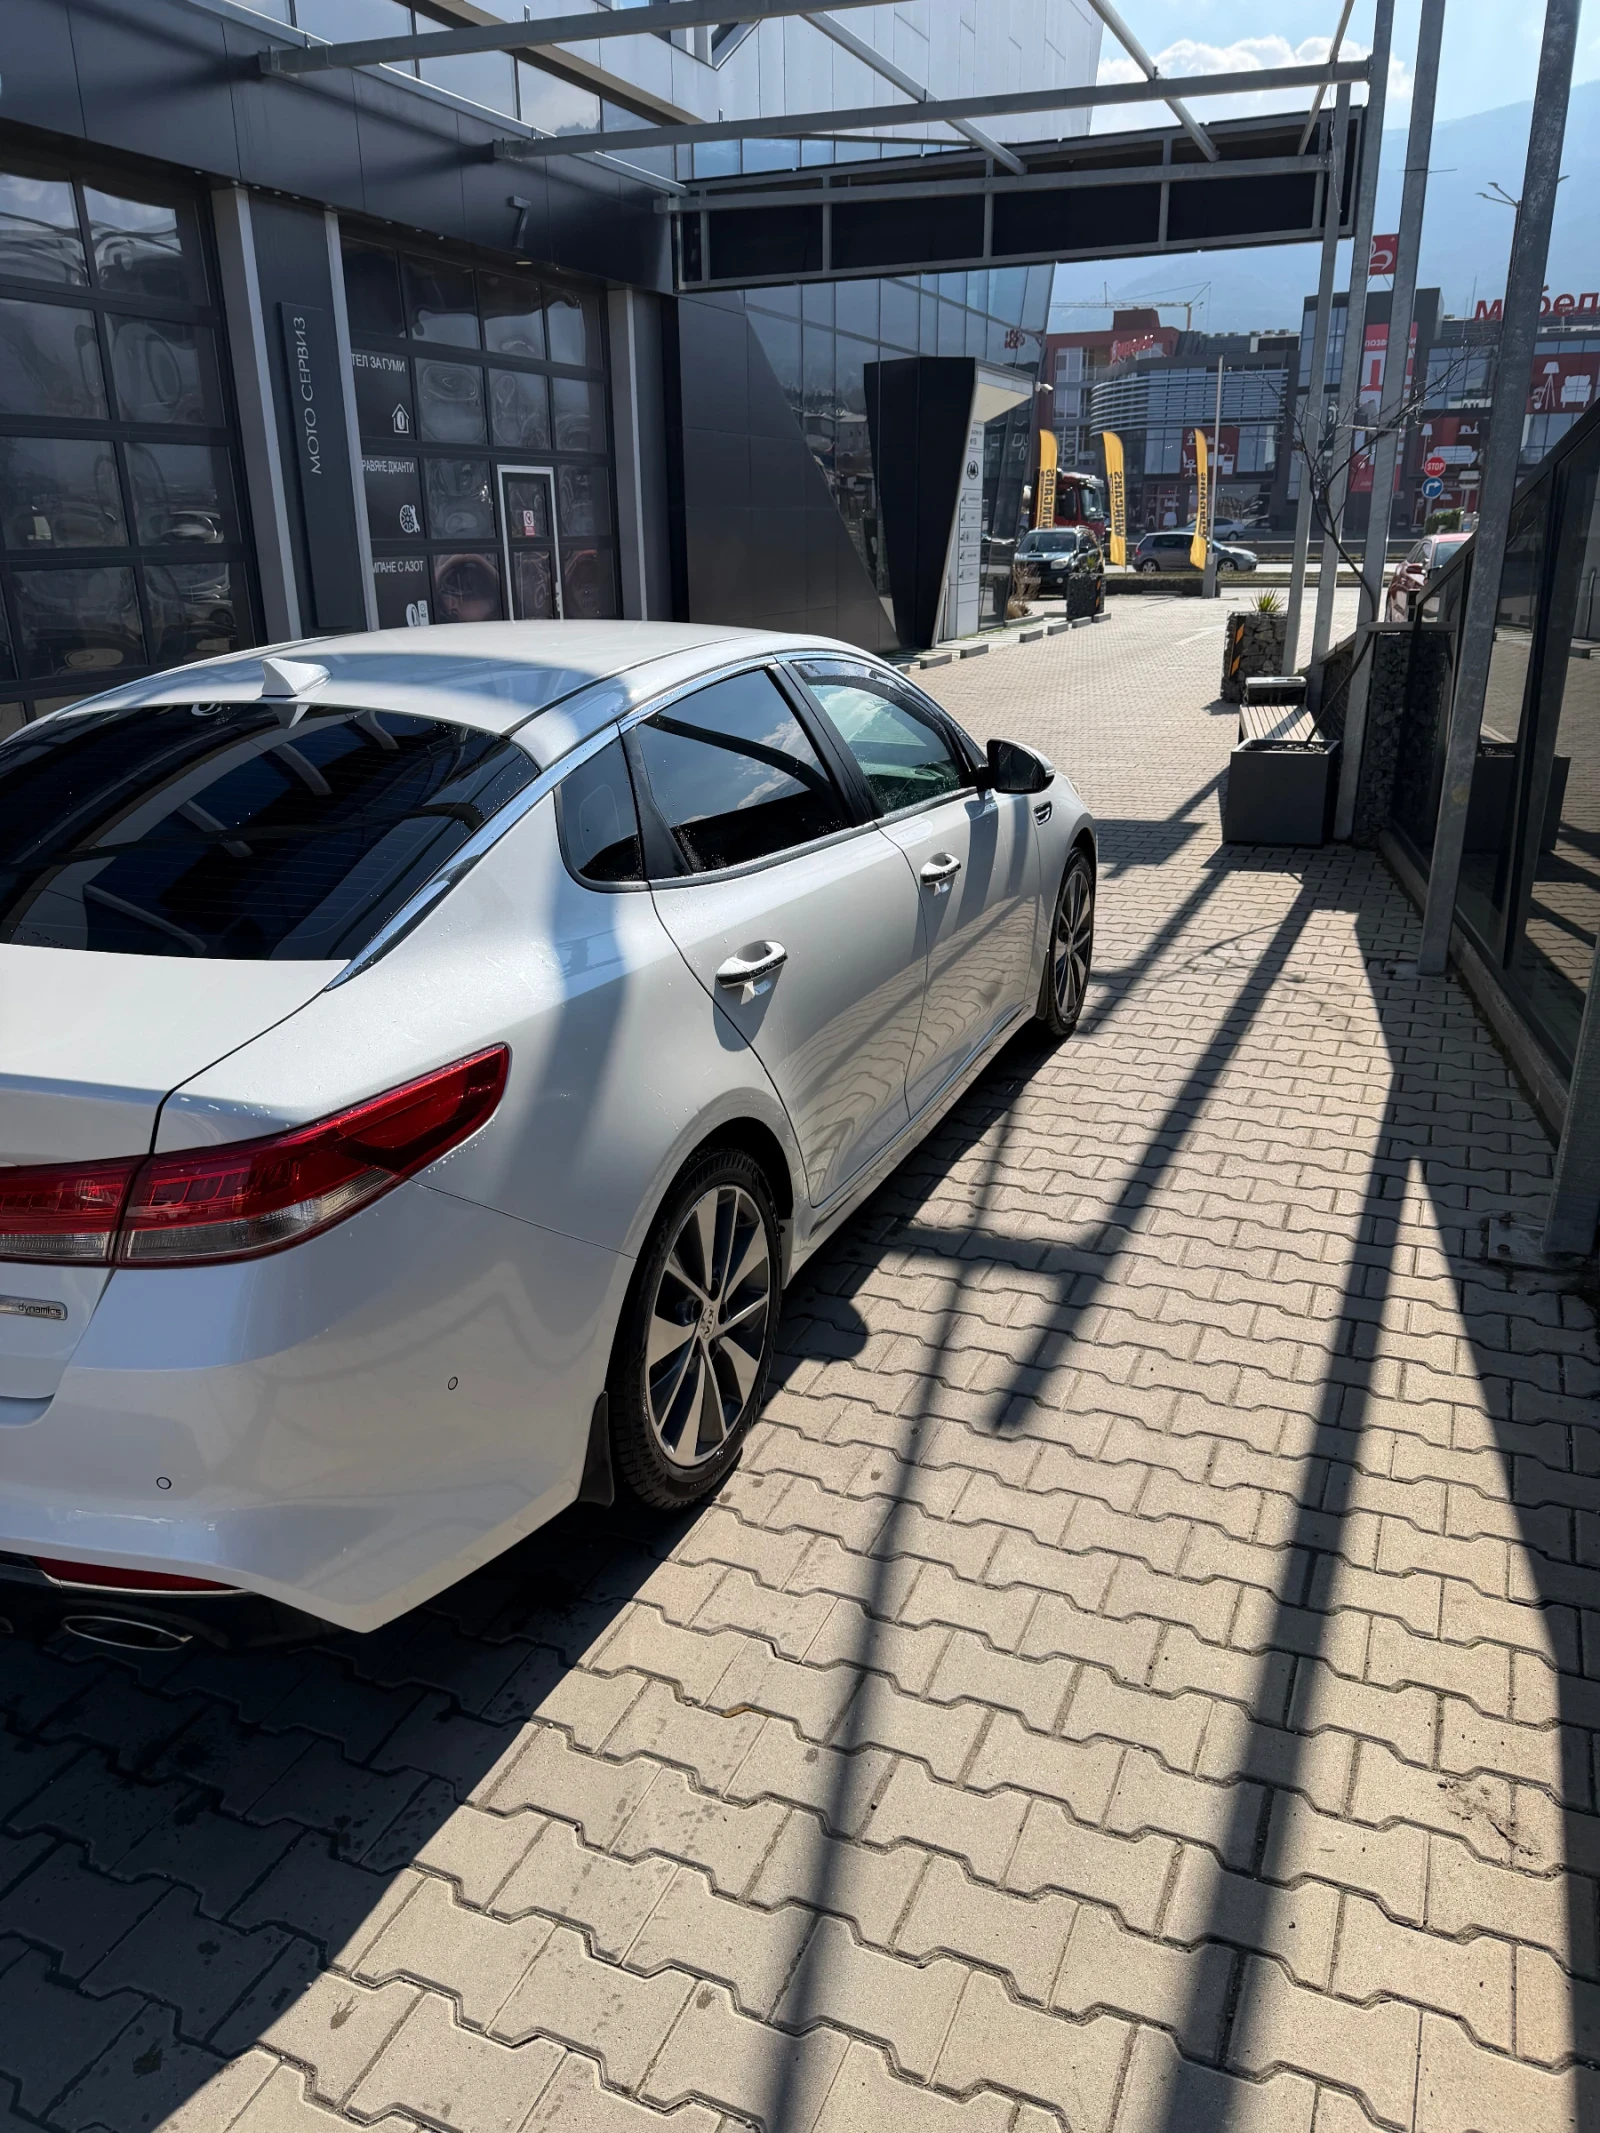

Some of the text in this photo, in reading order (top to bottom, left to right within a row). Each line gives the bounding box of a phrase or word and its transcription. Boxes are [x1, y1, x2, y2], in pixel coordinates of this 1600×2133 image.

[505, 195, 532, 249] 7
[1473, 284, 1600, 323] мбел
[369, 356, 382, 370] ЗА
[382, 357, 406, 373] ГУМИ
[293, 316, 322, 475] МОТО СЕРВИЗ
[388, 460, 415, 475] ДЖАНТИ
[1427, 462, 1445, 471] STOP
[397, 561, 404, 573] С
[404, 560, 424, 573] АЗОТ
